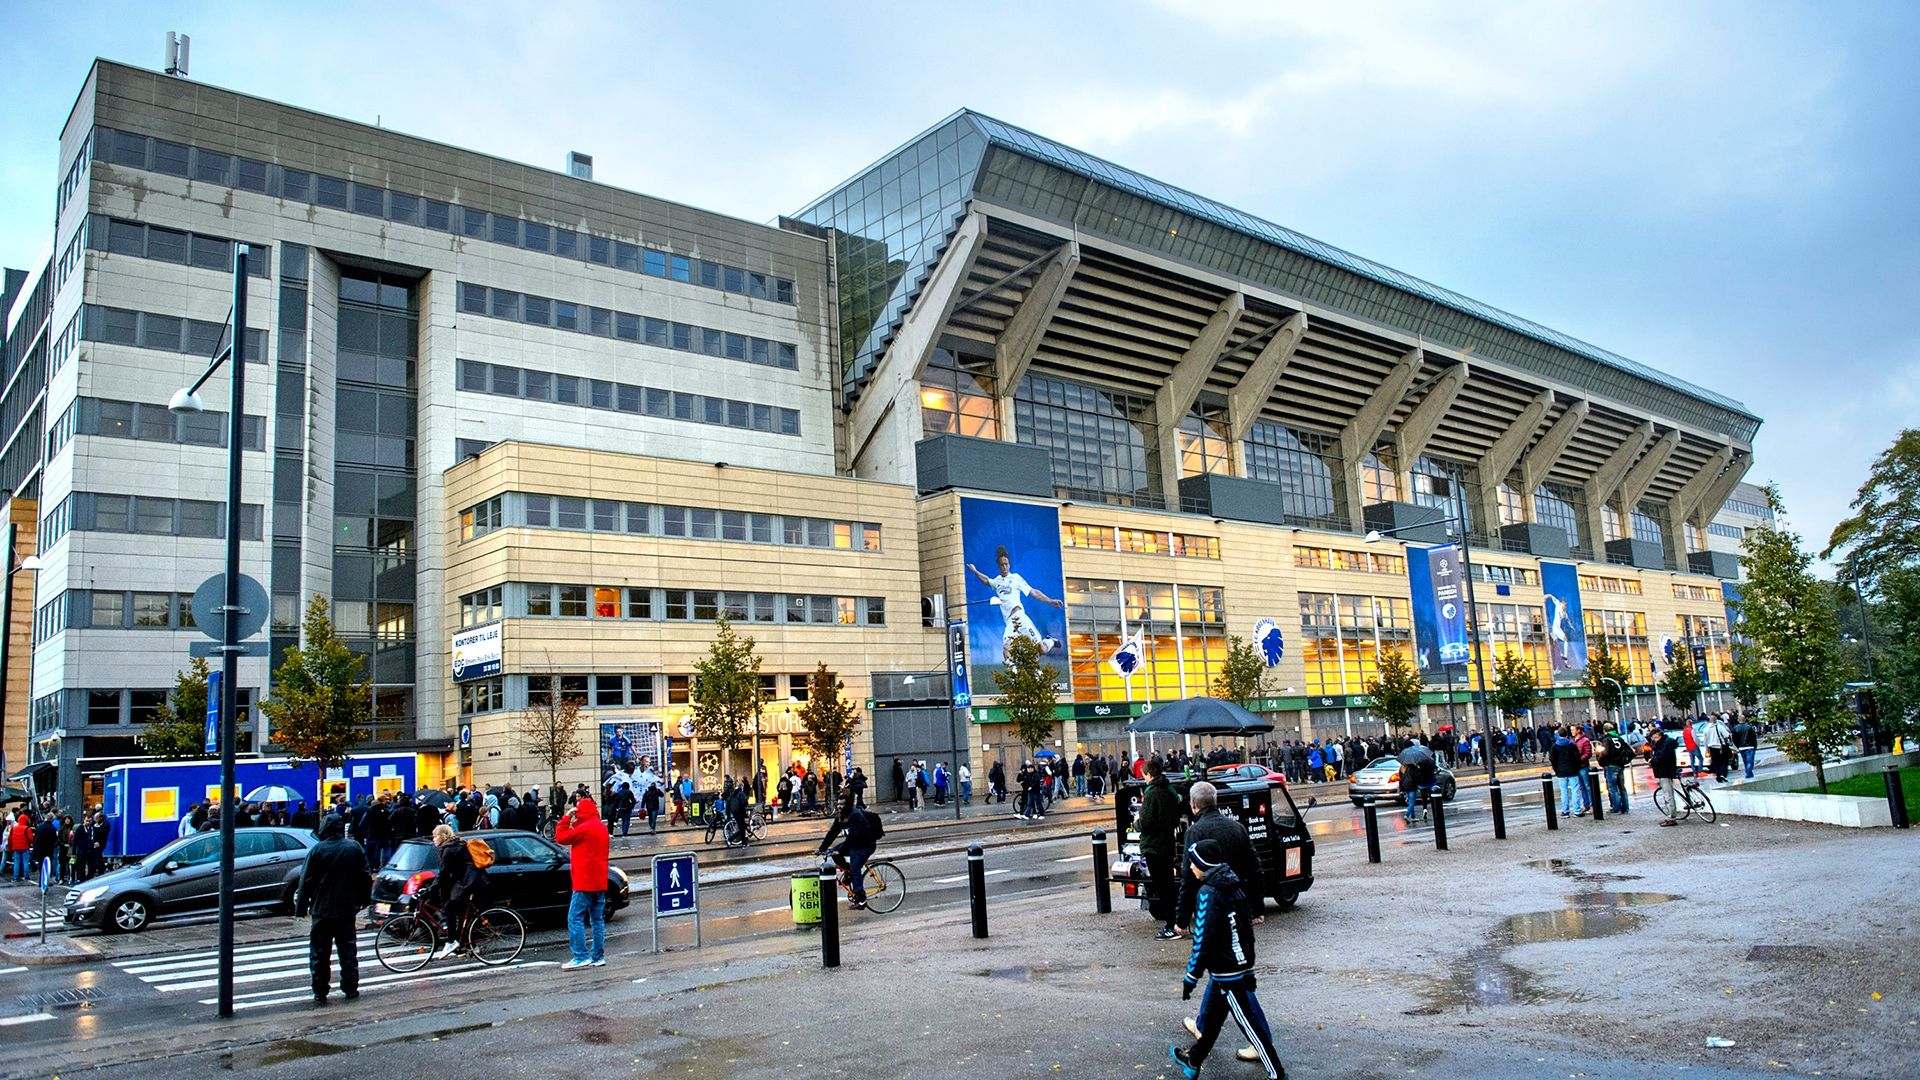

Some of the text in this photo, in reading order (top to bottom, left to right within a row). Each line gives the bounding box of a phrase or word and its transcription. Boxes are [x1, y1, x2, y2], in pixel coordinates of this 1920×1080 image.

[455, 659, 464, 668] EDC
[1612, 738, 1621, 748] 5
[800, 891, 819, 900] REN
[800, 901, 819, 909] KBH
[1228, 911, 1247, 965] hummel
